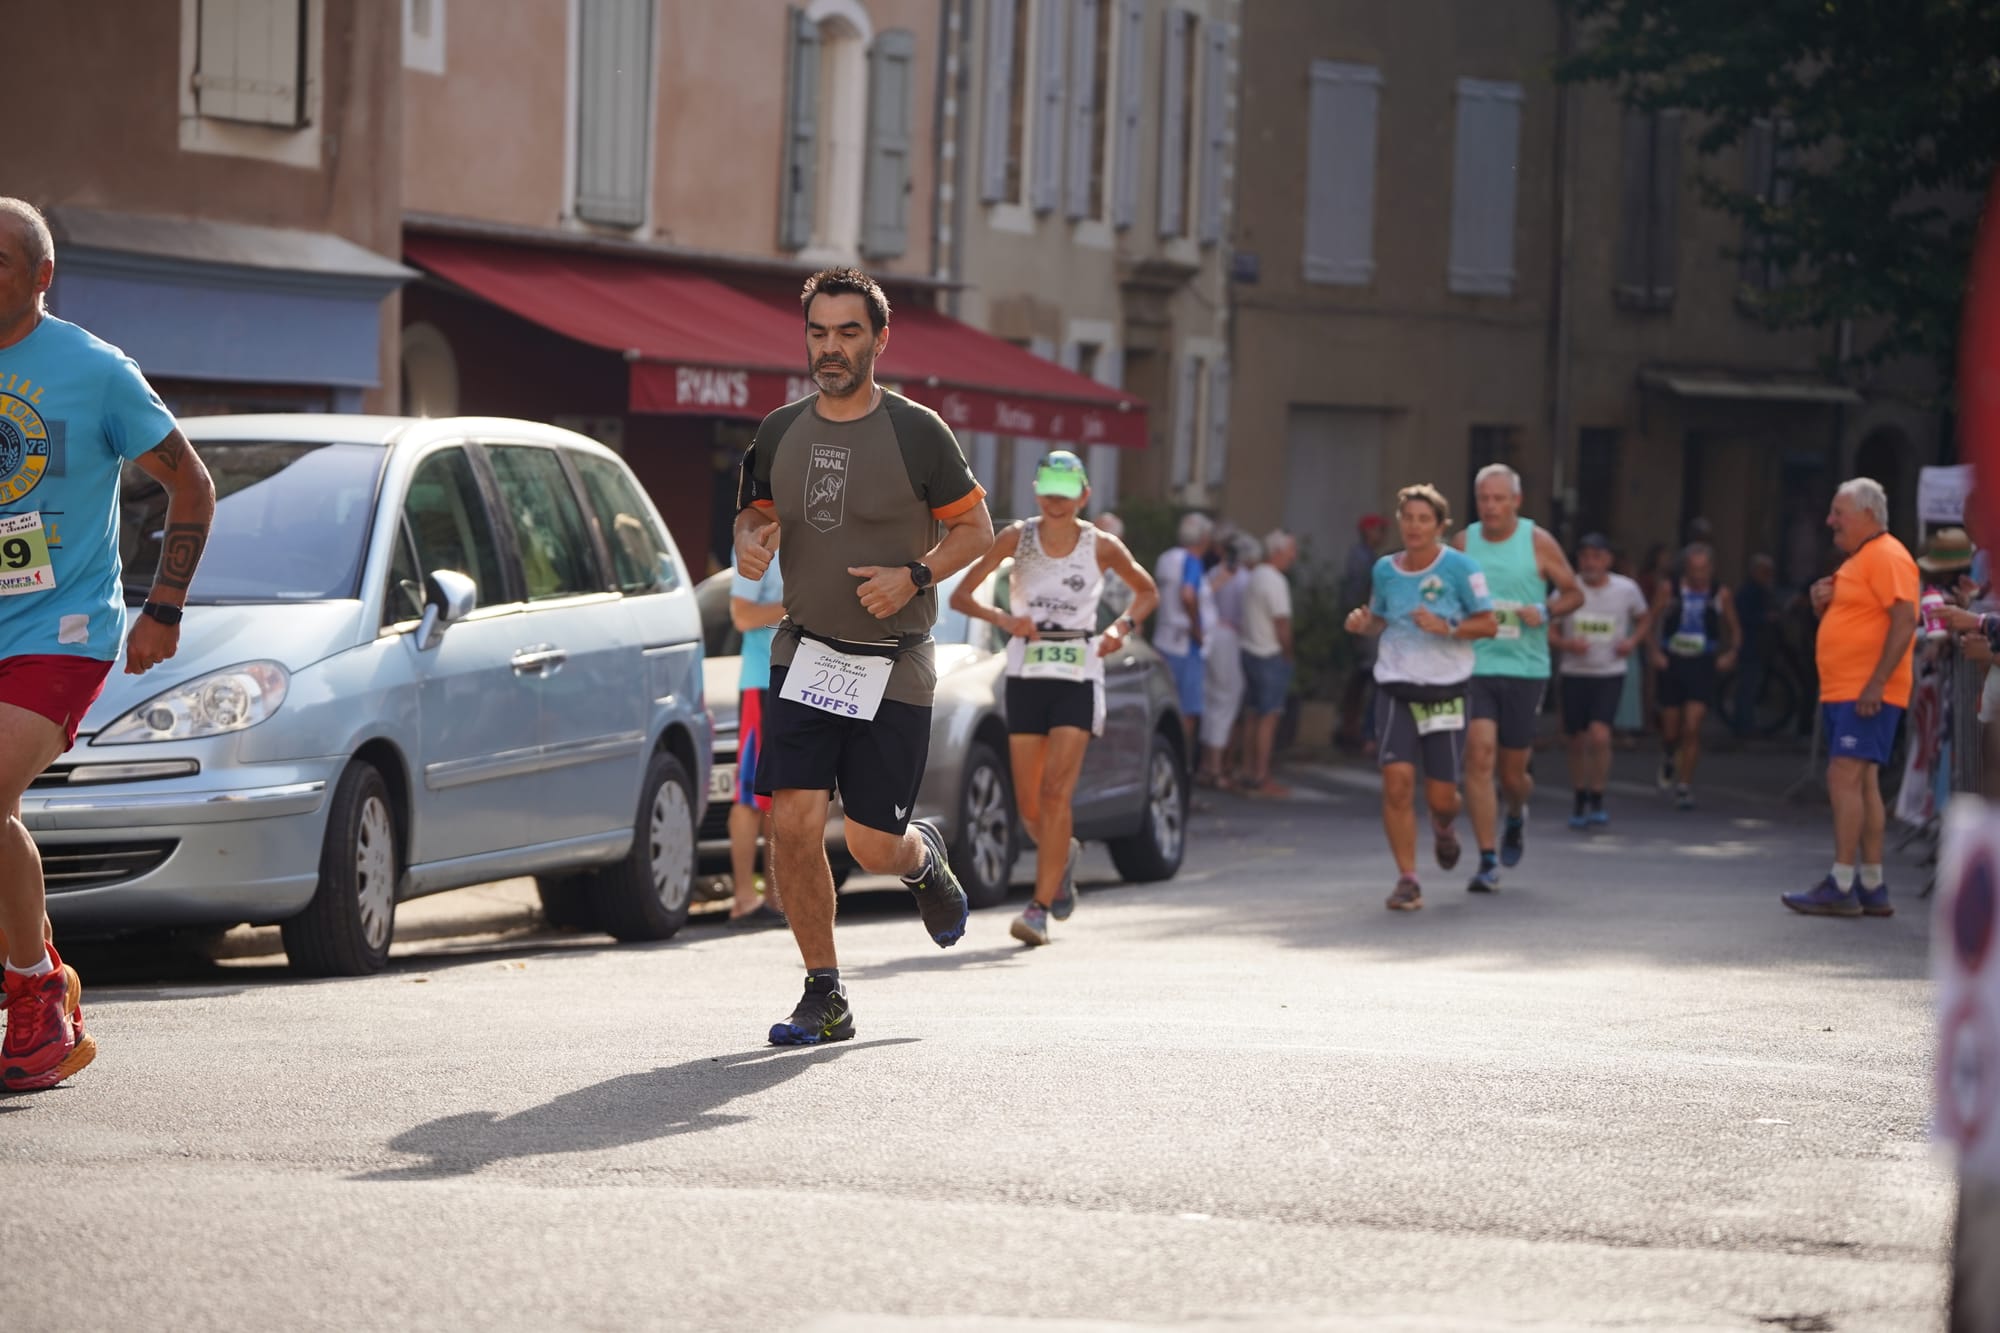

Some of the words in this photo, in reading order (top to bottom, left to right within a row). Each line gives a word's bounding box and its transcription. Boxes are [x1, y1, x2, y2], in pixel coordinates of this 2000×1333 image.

[676, 366, 748, 408] RYAN'S
[27, 439, 47, 455] 72
[814, 448, 846, 460] LOZÈRE
[814, 457, 844, 471] TRAIL
[0, 537, 32, 569] 9
[1033, 646, 1077, 664] 135
[808, 669, 860, 702] 204
[801, 690, 859, 716] TUFF'S
